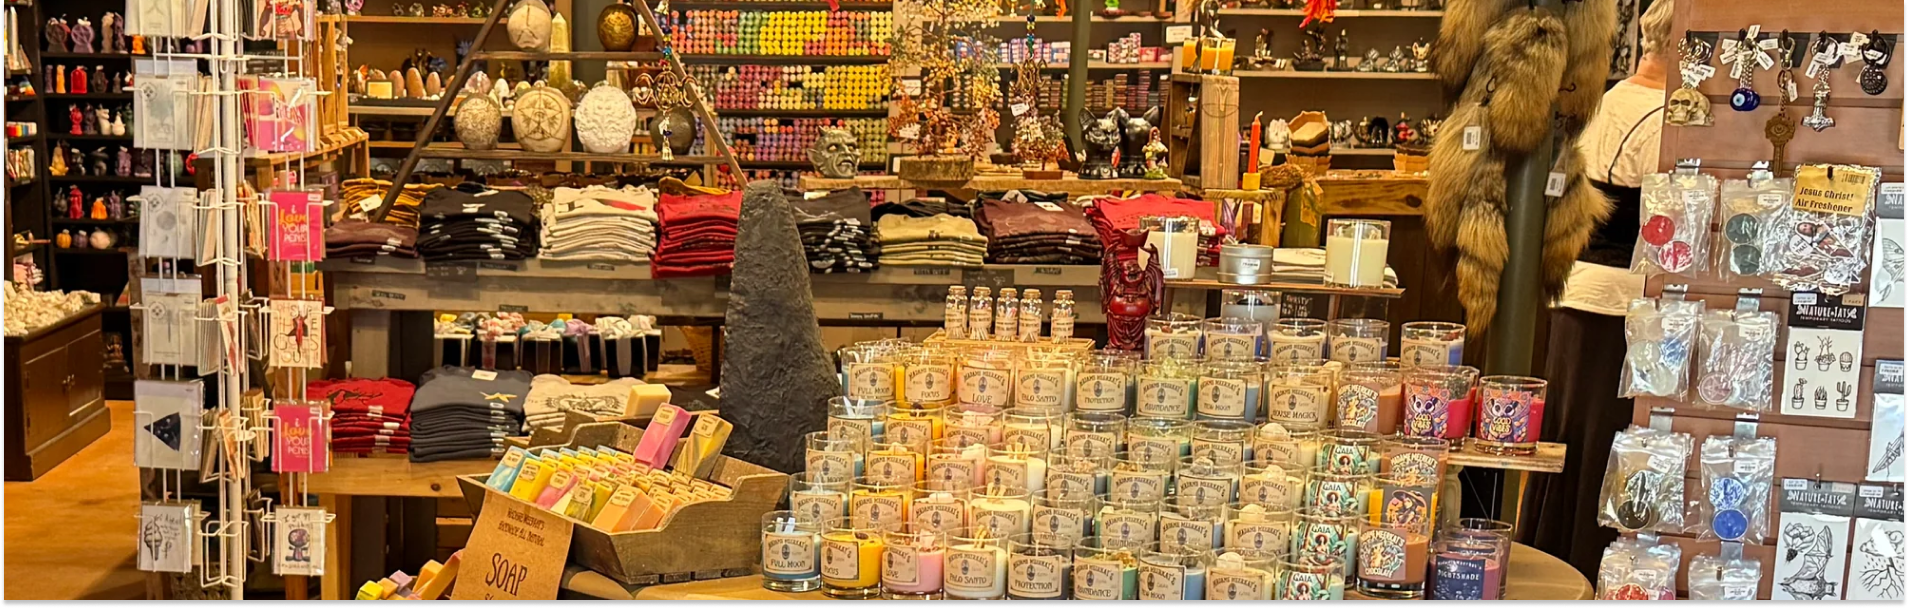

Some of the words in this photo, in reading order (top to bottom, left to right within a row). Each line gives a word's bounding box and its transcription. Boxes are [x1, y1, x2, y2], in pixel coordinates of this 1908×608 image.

[1800, 187, 1822, 196] Jesus
[1825, 190, 1854, 201] Christ!
[1796, 198, 1809, 206] Air
[1810, 200, 1853, 212] Freshener
[1804, 305, 1831, 316] NATURE
[972, 393, 992, 403] LOVE
[1036, 395, 1057, 403] SANTO
[1145, 403, 1180, 412] ABUNDANCE
[1292, 410, 1317, 419] MAGICK
[1335, 446, 1354, 455] GAIA
[1322, 482, 1341, 491] GAIA
[1794, 491, 1821, 503] NATURE
[1871, 498, 1898, 510] NATURE
[1312, 525, 1330, 534] GAIA
[770, 559, 785, 568] FULL
[787, 560, 806, 568] MOON
[485, 553, 528, 596] SOAP
[886, 570, 899, 578] LOVE
[1293, 573, 1313, 582] GAIA
[964, 576, 987, 584] SANTO
[1015, 580, 1052, 589] PROTECTION
